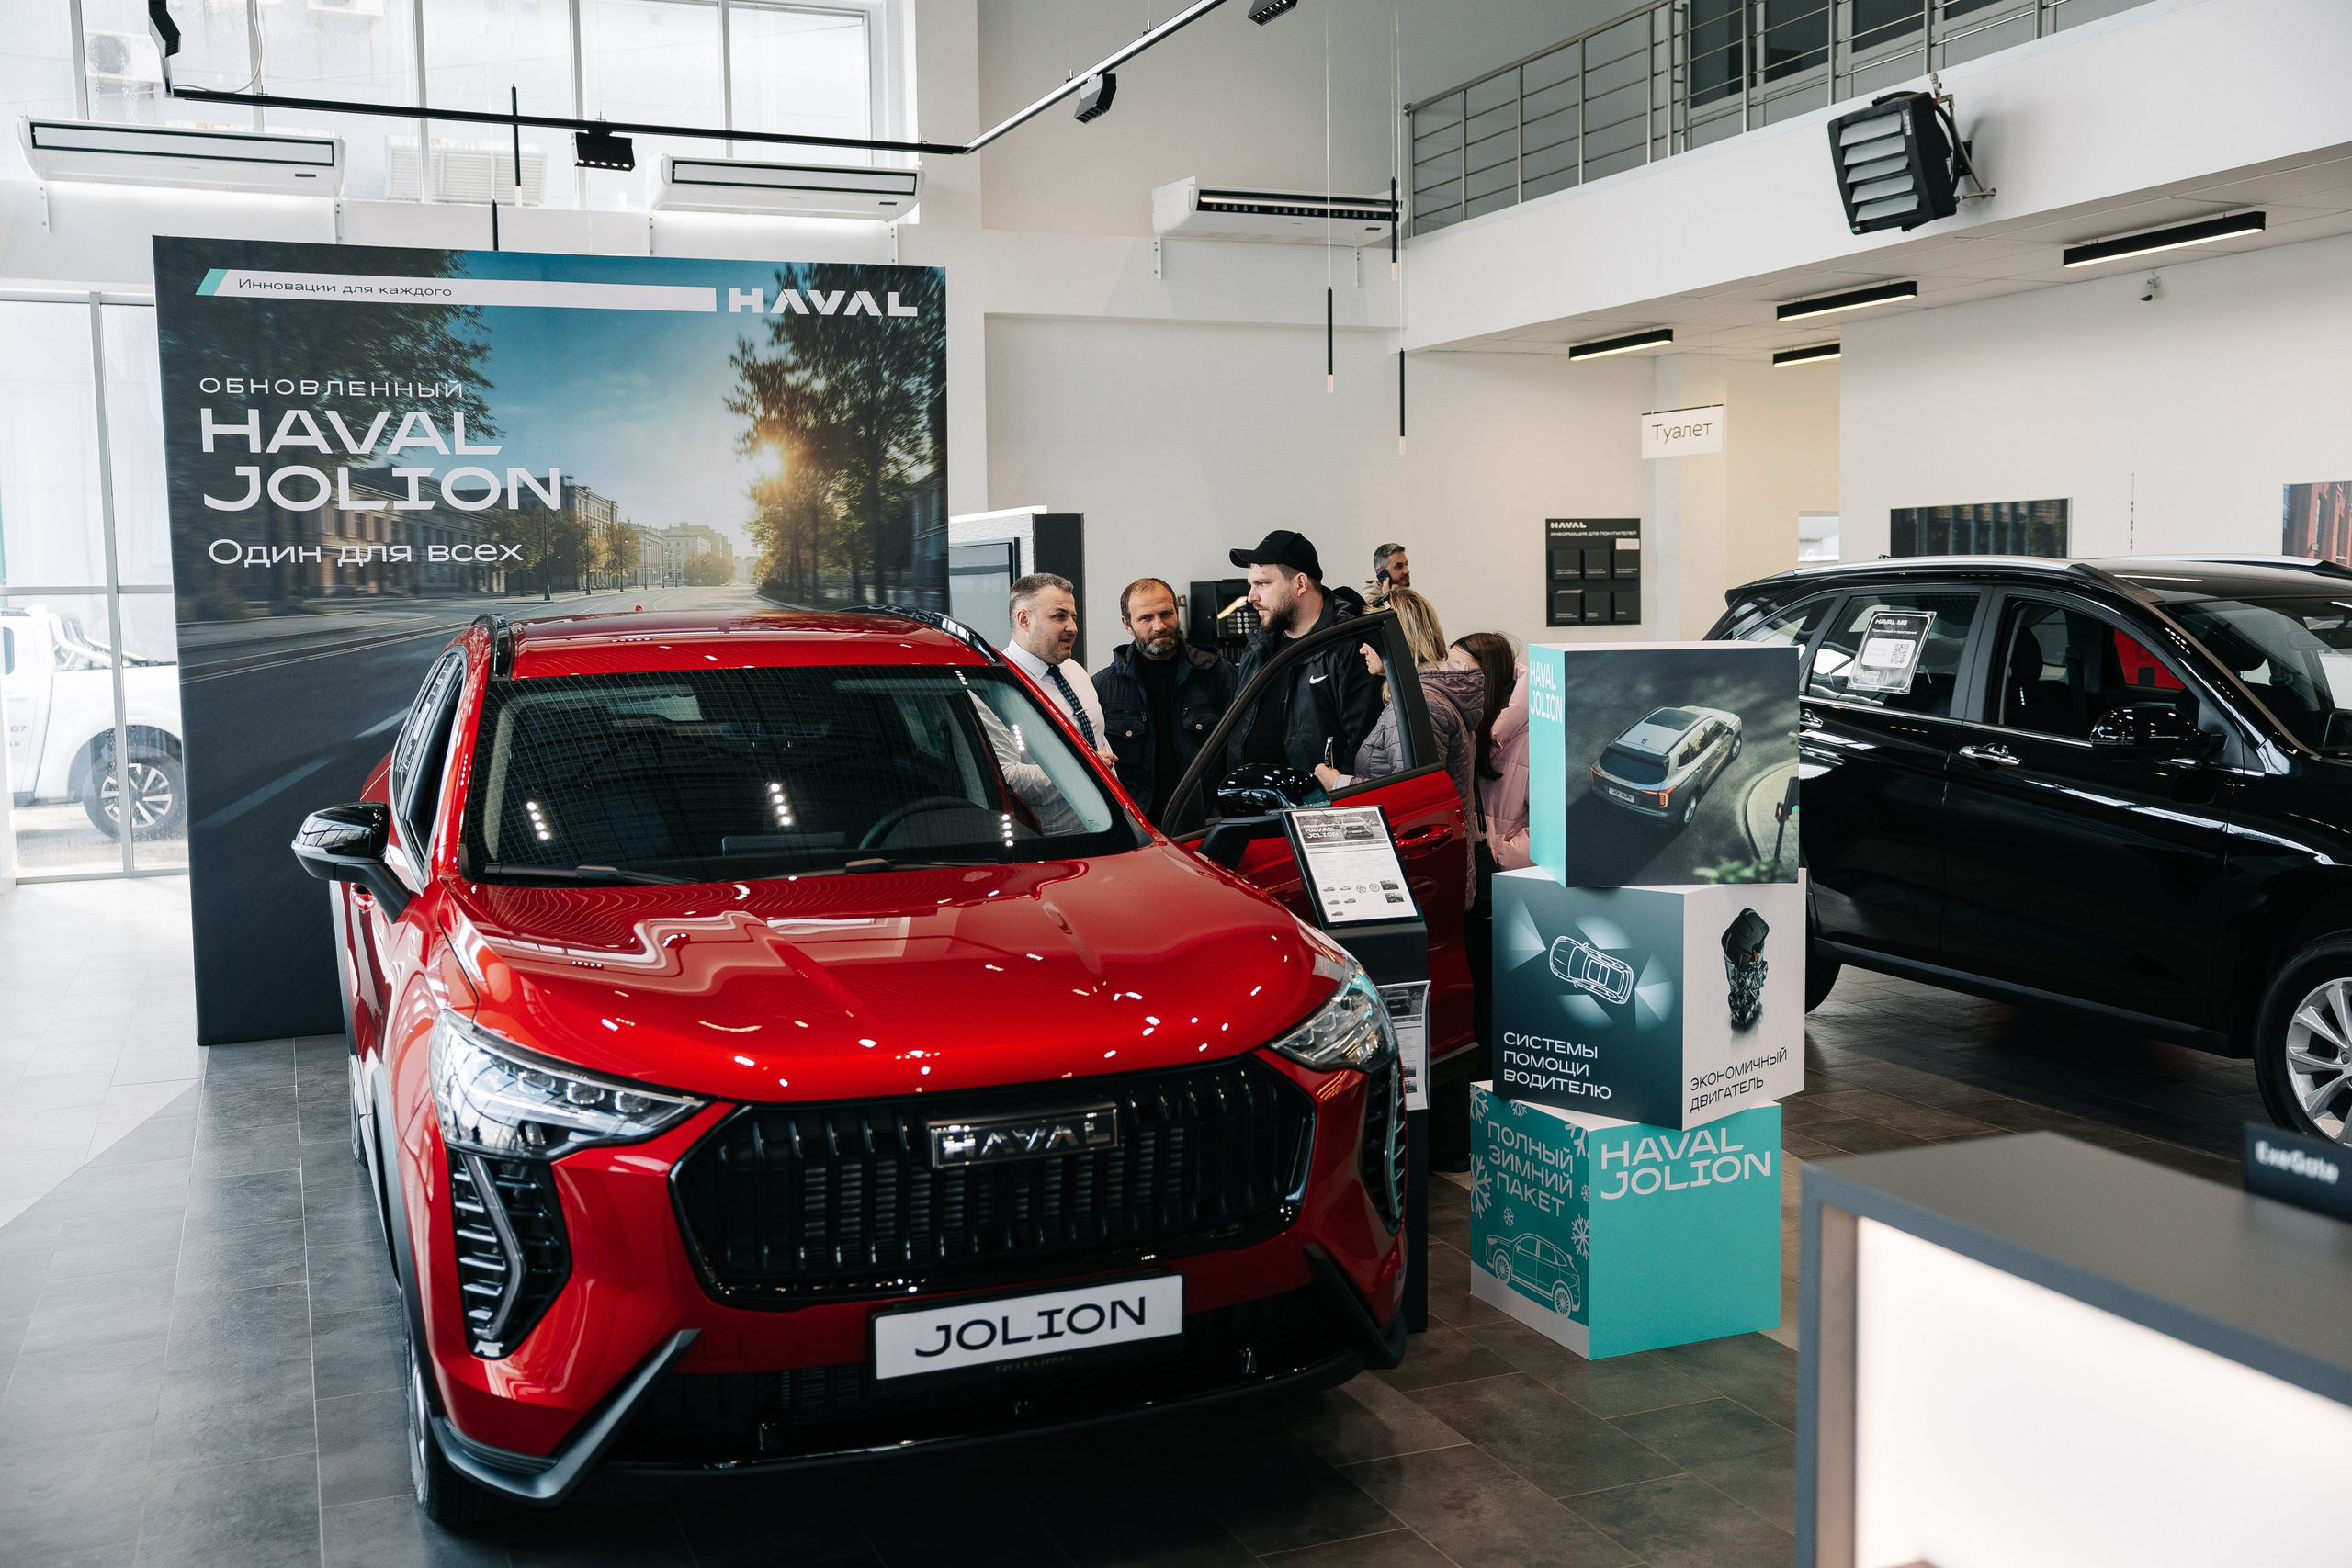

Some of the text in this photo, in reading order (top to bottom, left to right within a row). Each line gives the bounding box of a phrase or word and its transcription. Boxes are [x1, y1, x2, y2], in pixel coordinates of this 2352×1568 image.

[238, 278, 452, 297] Инновации для каждого
[729, 288, 918, 317] HAVAL
[199, 377, 463, 398] ОБНОВЛЕННЫЙ
[200, 408, 503, 455] HAVAL
[1652, 423, 1713, 444] Туалет
[203, 465, 561, 512] JOLION
[209, 538, 524, 568] Один для всех
[1530, 660, 1557, 691] HAVAL
[1530, 689, 1563, 724] JOLION
[1611, 790, 1632, 800] JOLION
[1503, 1032, 1599, 1059] СИСТЕМЫ
[1504, 1050, 1589, 1077] ПОМОЩИ
[1503, 1068, 1611, 1100] ВОДИТЕЛЮ
[1690, 1047, 1788, 1091] ЭКОНОМИЧНЫЙ
[1690, 1077, 1765, 1114] ДВИГАТЕЛЬ
[942, 1121, 1112, 1159] HAVAL
[1487, 1120, 1574, 1175] ПОЛНЫЙ
[1600, 1127, 1745, 1170] HAVAL
[1488, 1145, 1573, 1199] ЗИМНИЙ
[1600, 1151, 1771, 1201] JOLION
[1496, 1172, 1566, 1218] ПАКЕТ
[915, 1296, 1147, 1358] JOLION
